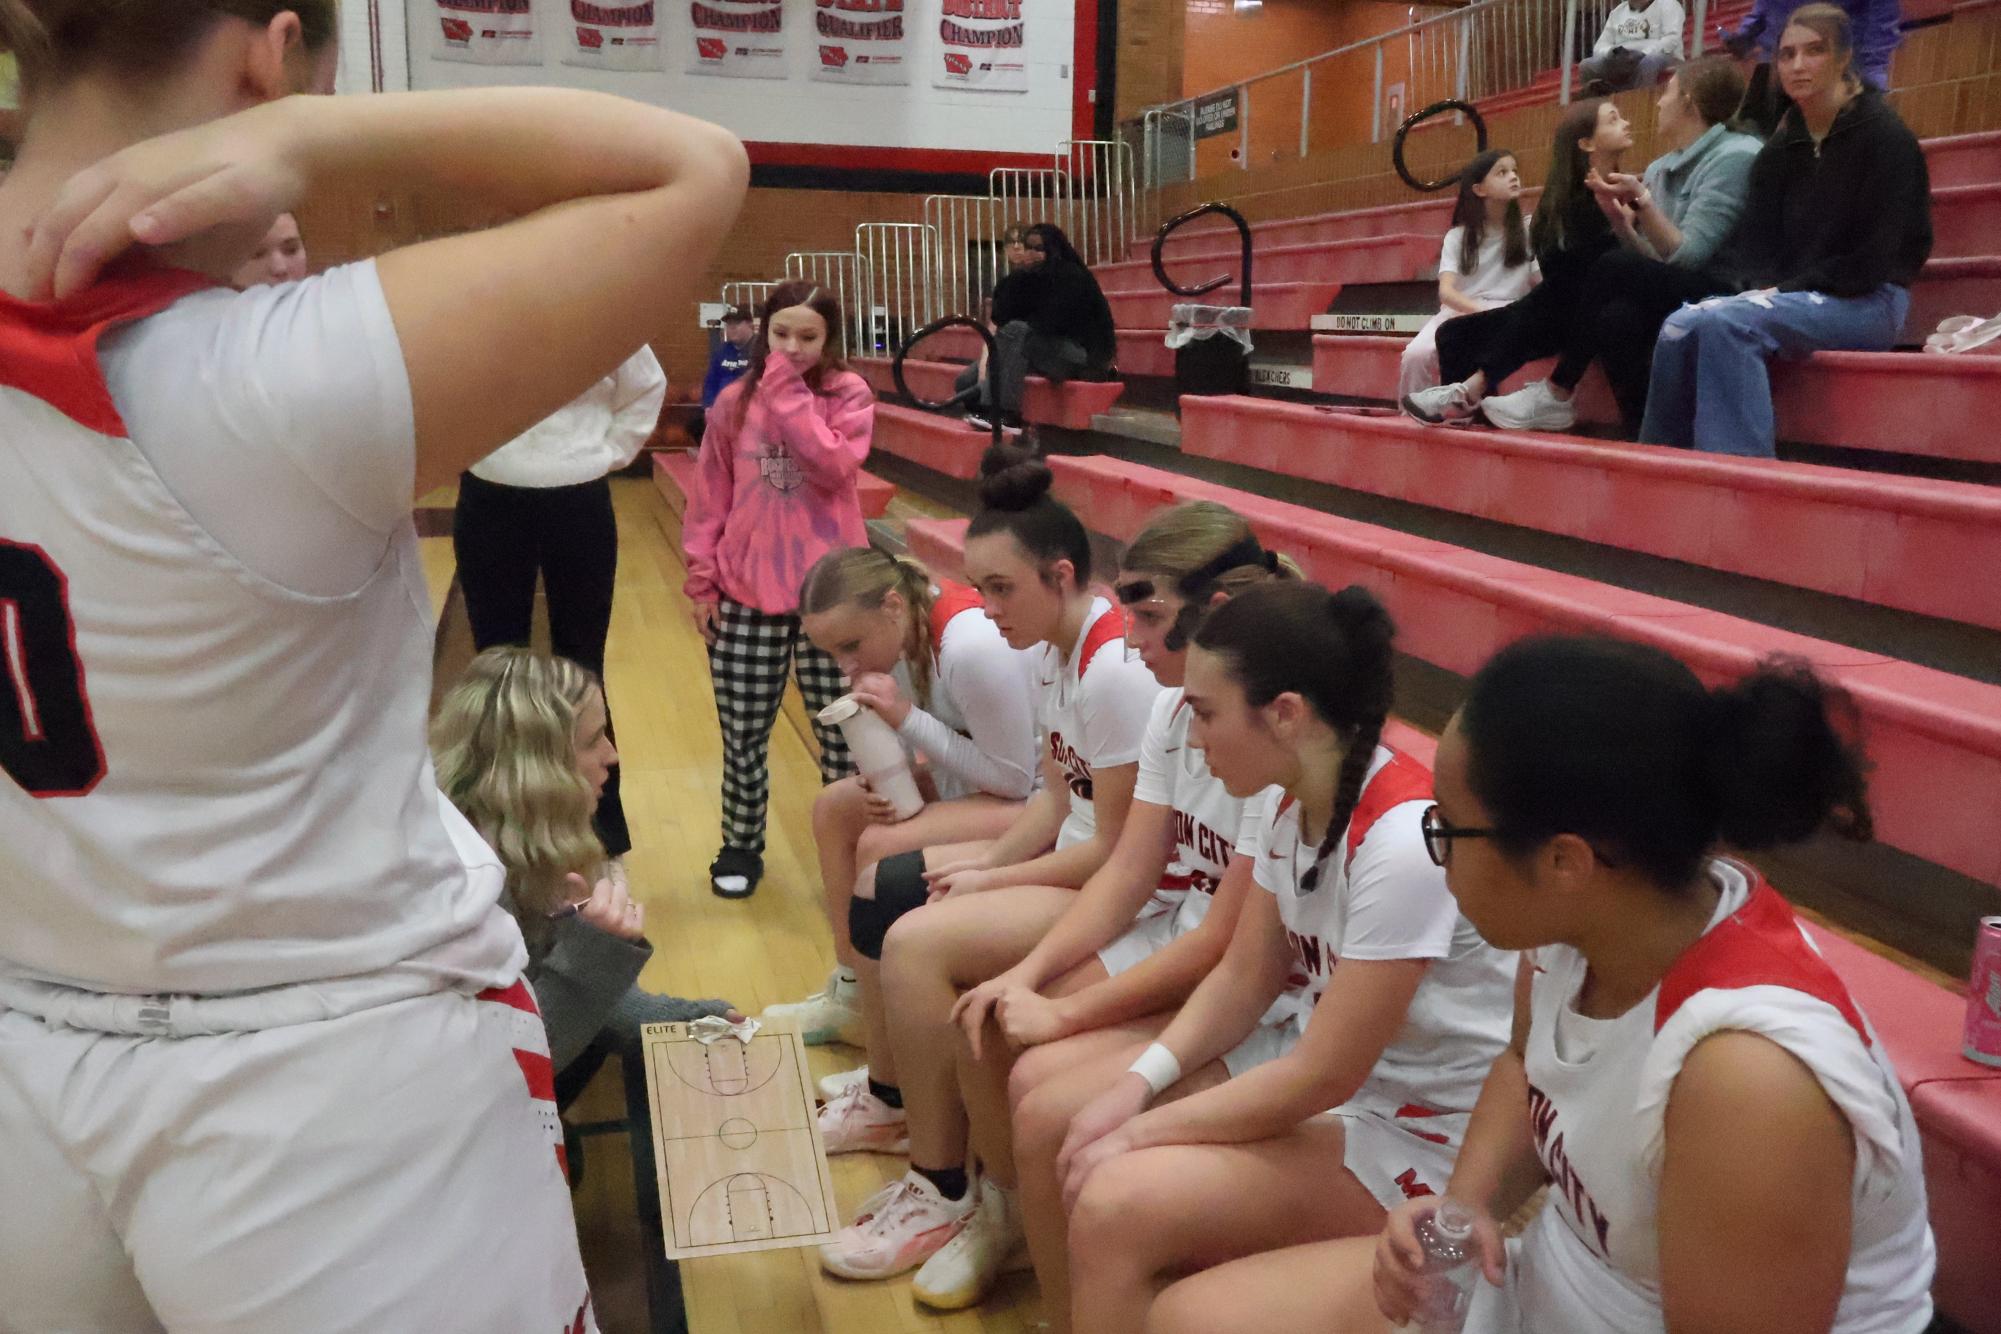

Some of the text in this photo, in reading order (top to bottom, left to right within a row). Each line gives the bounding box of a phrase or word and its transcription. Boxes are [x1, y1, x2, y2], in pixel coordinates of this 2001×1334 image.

[691, 2, 782, 32] CHAMPION
[816, 11, 904, 40] QUALIFIER
[940, 19, 1024, 48] CHAMPION
[1336, 317, 1395, 330] DO NOT CLIMB ON
[1199, 822, 1236, 869] CIT
[646, 1024, 677, 1035] ELITE
